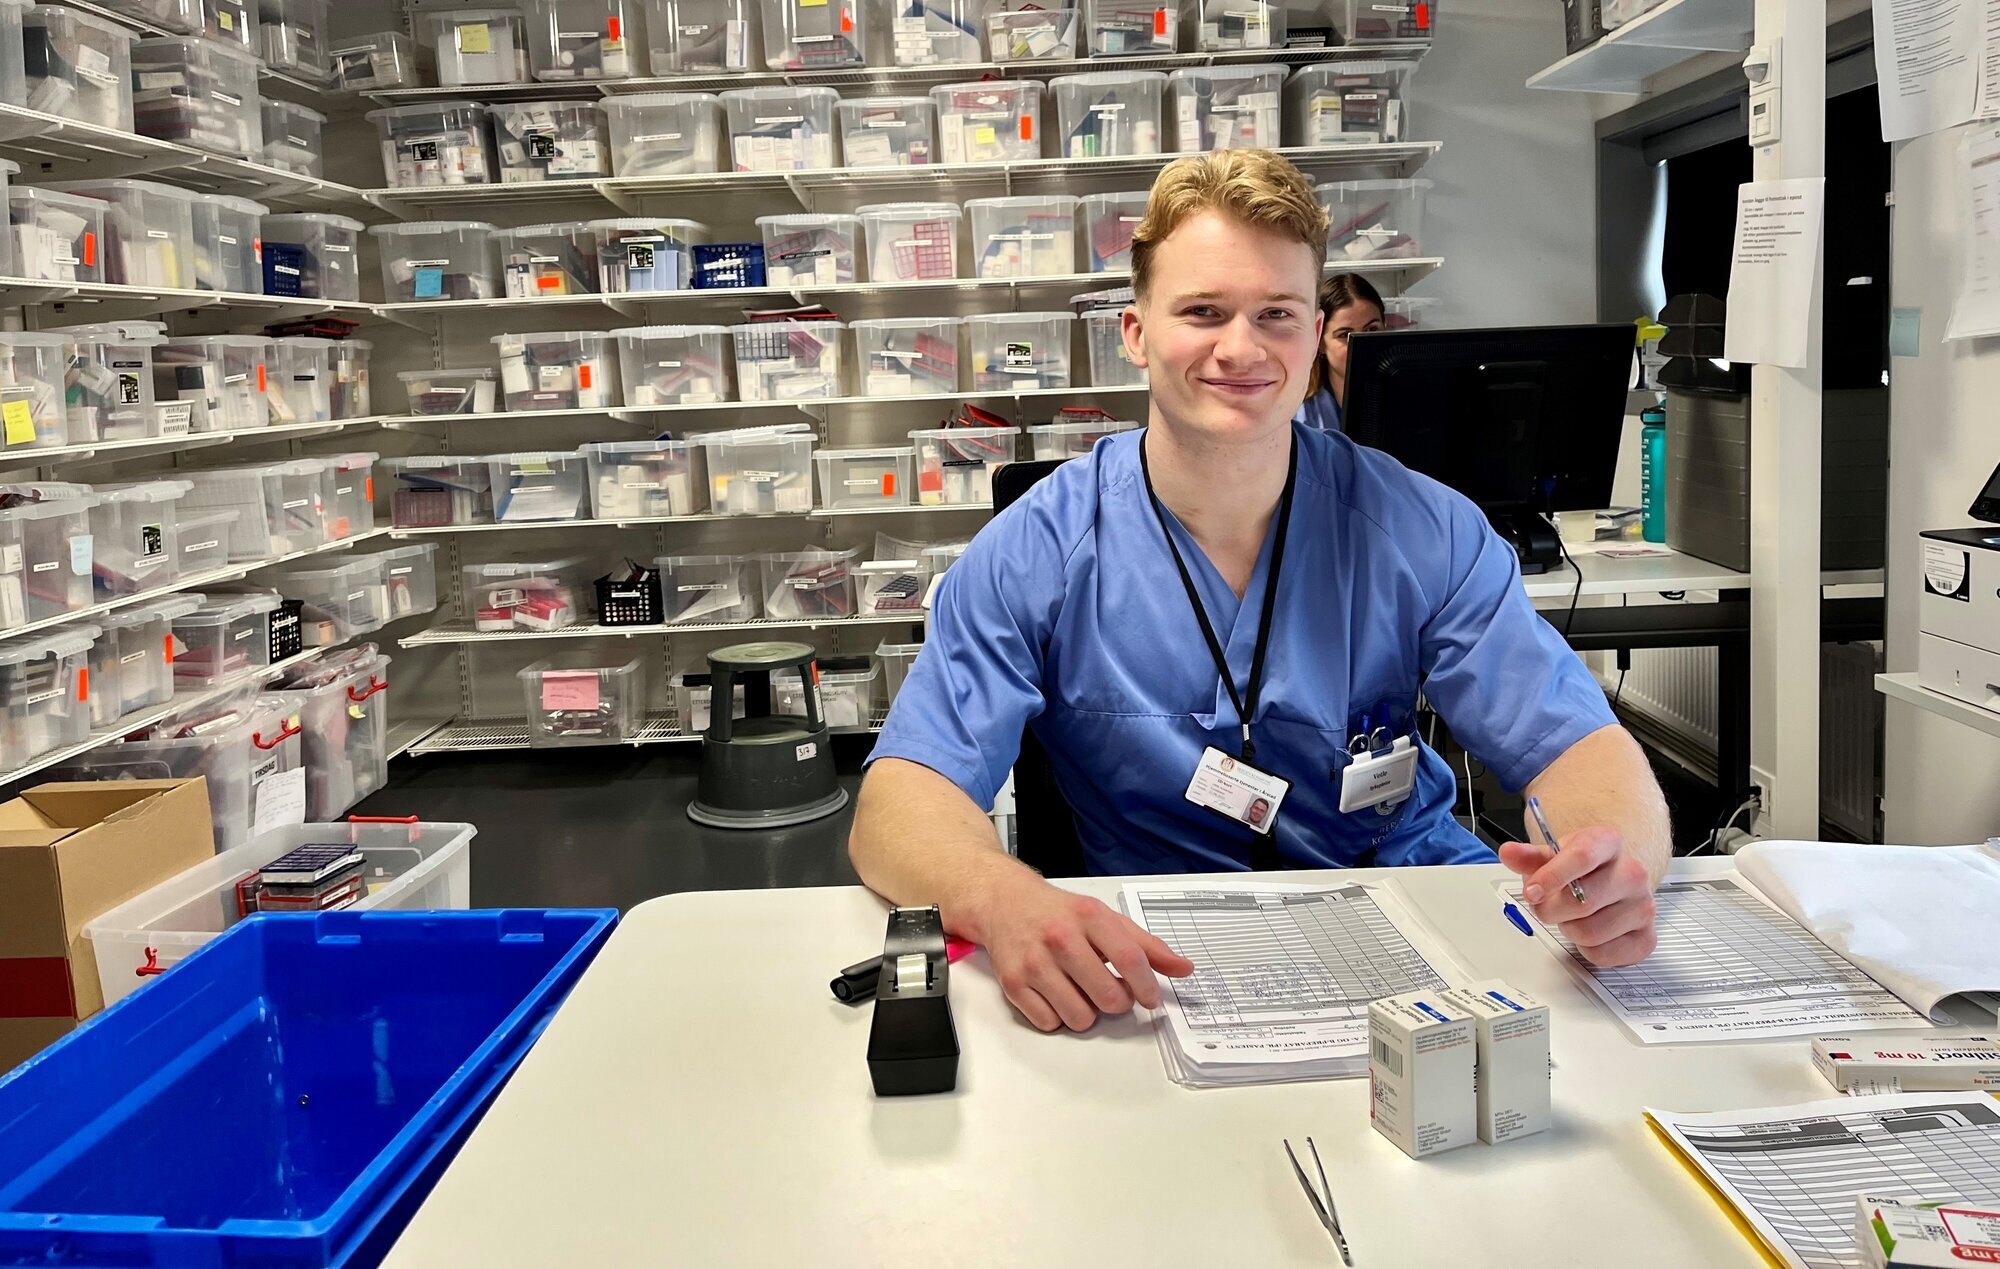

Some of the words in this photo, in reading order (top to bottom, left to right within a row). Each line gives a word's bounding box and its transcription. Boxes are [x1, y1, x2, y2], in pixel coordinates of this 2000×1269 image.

[254, 761, 275, 778] TIRSDAG
[1373, 771, 1388, 780] Vetle
[1874, 1051, 1904, 1060] mg
[1906, 1052, 1927, 1061] 10
[1867, 1197, 1900, 1205] teva
[1960, 1247, 1991, 1260] mg
